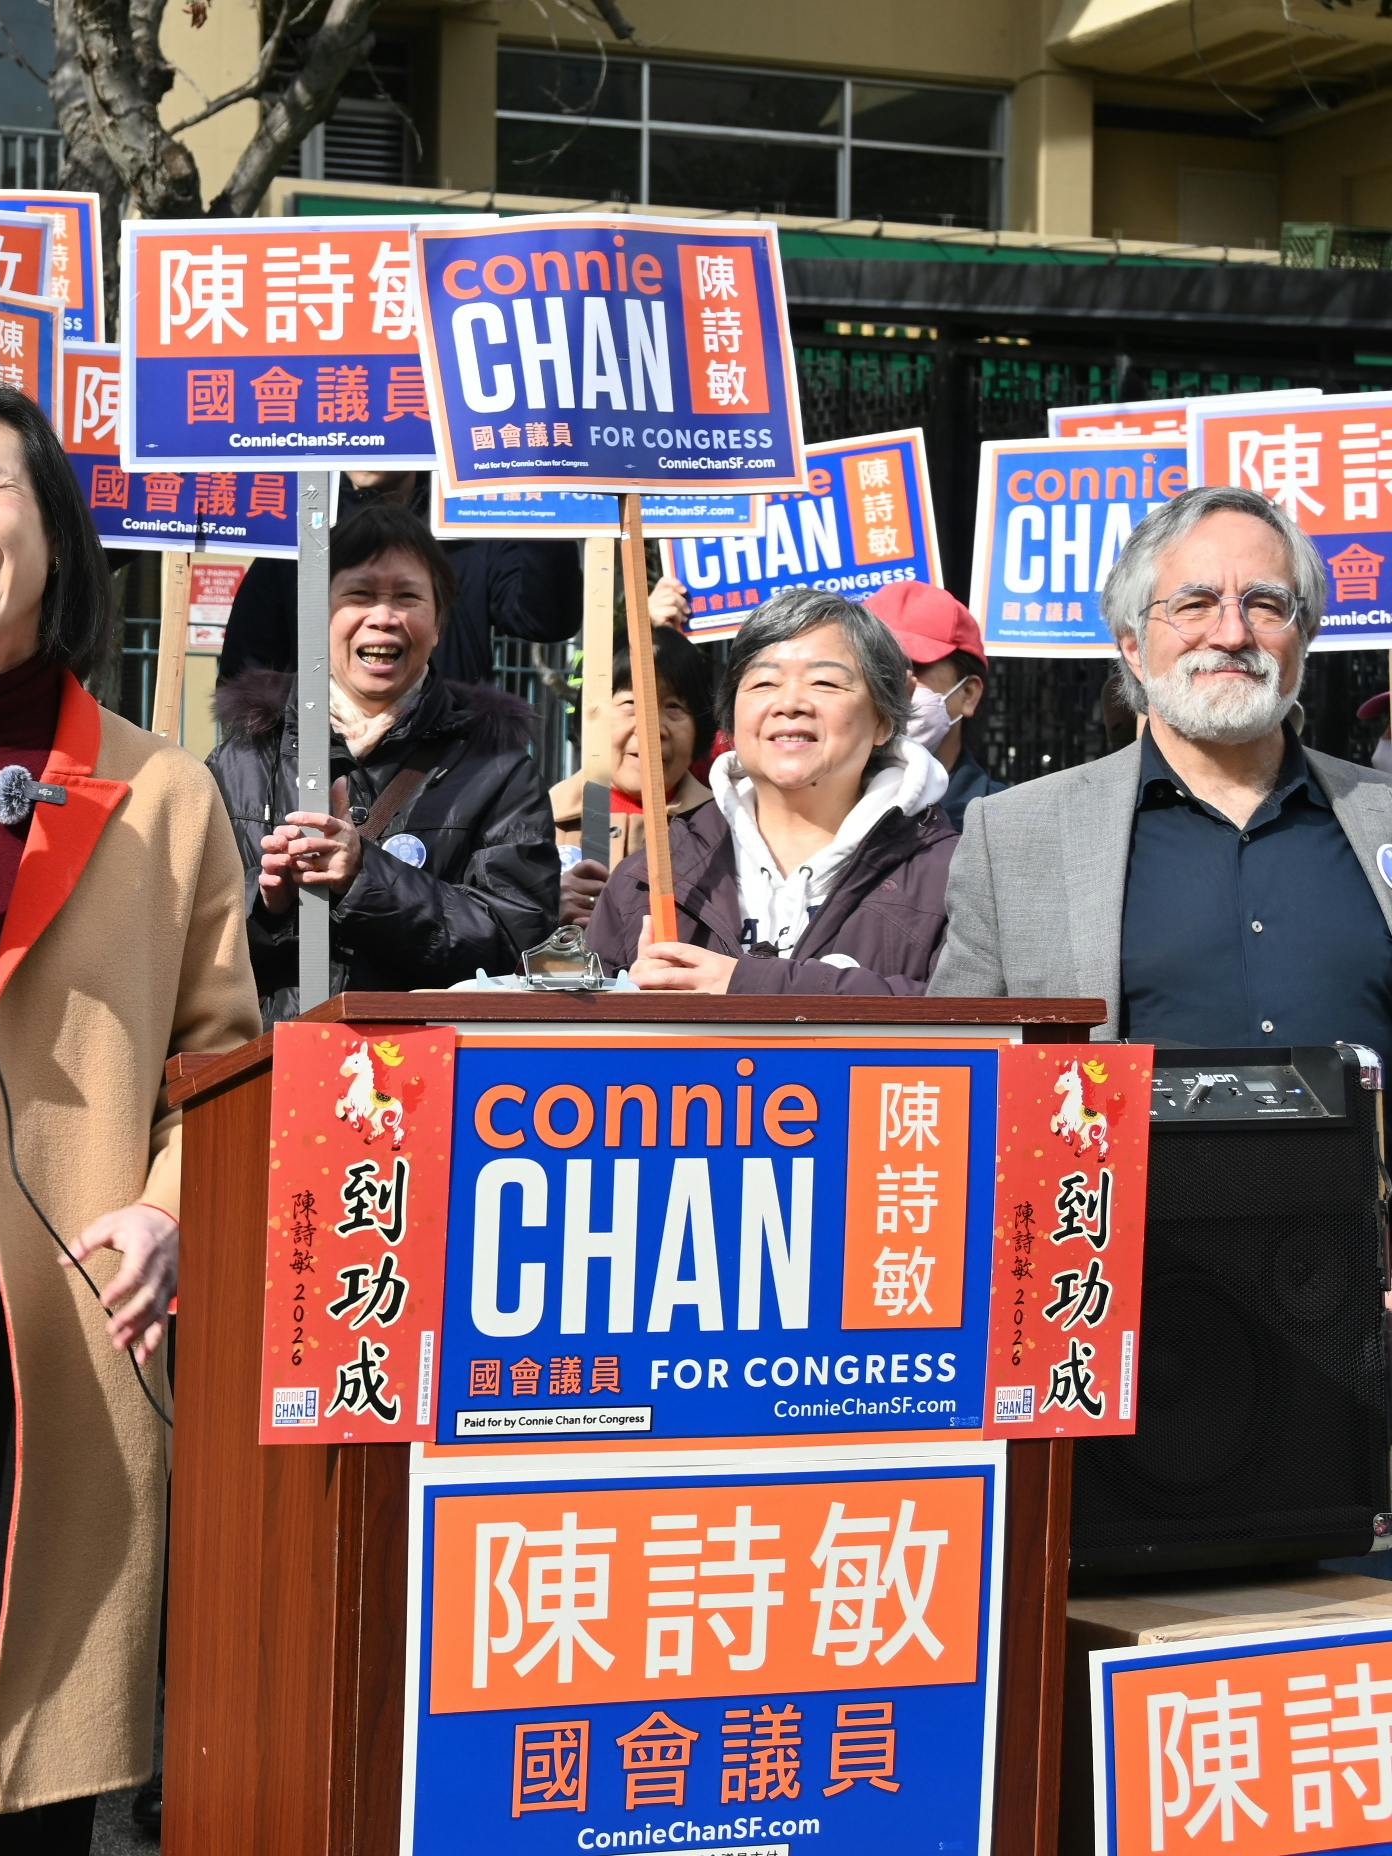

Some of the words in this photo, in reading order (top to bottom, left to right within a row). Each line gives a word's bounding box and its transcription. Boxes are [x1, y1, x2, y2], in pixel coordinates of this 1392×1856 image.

[443, 235, 664, 299] connie
[451, 296, 674, 414] CHAN
[695, 255, 750, 408] 陳詩敏
[187, 365, 431, 425] 國會議員
[229, 432, 385, 449] ConnieChanSF.com
[470, 422, 573, 452] 國會議員
[474, 462, 489, 470] Paid
[490, 461, 500, 470] for
[500, 461, 510, 470] by
[511, 460, 535, 469] Connie
[535, 459, 552, 467] Chan
[552, 459, 561, 467] for
[561, 459, 589, 469] Congress
[590, 426, 636, 448] FOR
[642, 428, 773, 449] CONGRESS
[658, 457, 776, 470] ConnieChanSF.com
[90, 465, 288, 520] 國會議員
[1008, 453, 1188, 502] connie
[122, 517, 247, 537] ConnieChanSF.com
[640, 505, 734, 517] nnieChanSF.com
[858, 458, 900, 557] 陳詩敏
[1003, 502, 1168, 594] CHA
[813, 566, 916, 593] CONGRESS
[473, 1057, 819, 1149] connie
[872, 1080, 941, 1316] 陳詩敏
[289, 1189, 319, 1275] 陳詩敏
[470, 1157, 815, 1338] CHAN
[1011, 1200, 1035, 1281] 陳詩敏
[328, 1160, 408, 1420] 到功成
[1042, 1170, 1111, 1417] 到功成
[291, 1283, 306, 1367] 2026
[1012, 1288, 1026, 1367] 2026
[275, 1391, 304, 1403] connie
[469, 1355, 622, 1398] 國會議員
[650, 1358, 729, 1390] FOR
[744, 1353, 956, 1388] CONGRESS
[997, 1389, 1022, 1400] connie
[275, 1403, 304, 1418] CHAN
[464, 1417, 485, 1428] Paid
[487, 1416, 503, 1427] for
[504, 1416, 516, 1428] by
[518, 1415, 553, 1426] Connie
[555, 1415, 581, 1425] Chan
[582, 1415, 597, 1425] for
[598, 1414, 645, 1426] Congress
[774, 1396, 956, 1419] ConnieChanSF.com
[996, 1400, 1021, 1415] CHAN
[472, 1499, 949, 1689] 陳詩敏
[512, 1702, 903, 1818] 國會議員
[1146, 1661, 1392, 1852] 陳詩
[577, 1814, 820, 1851] ConnieChanSF.com
